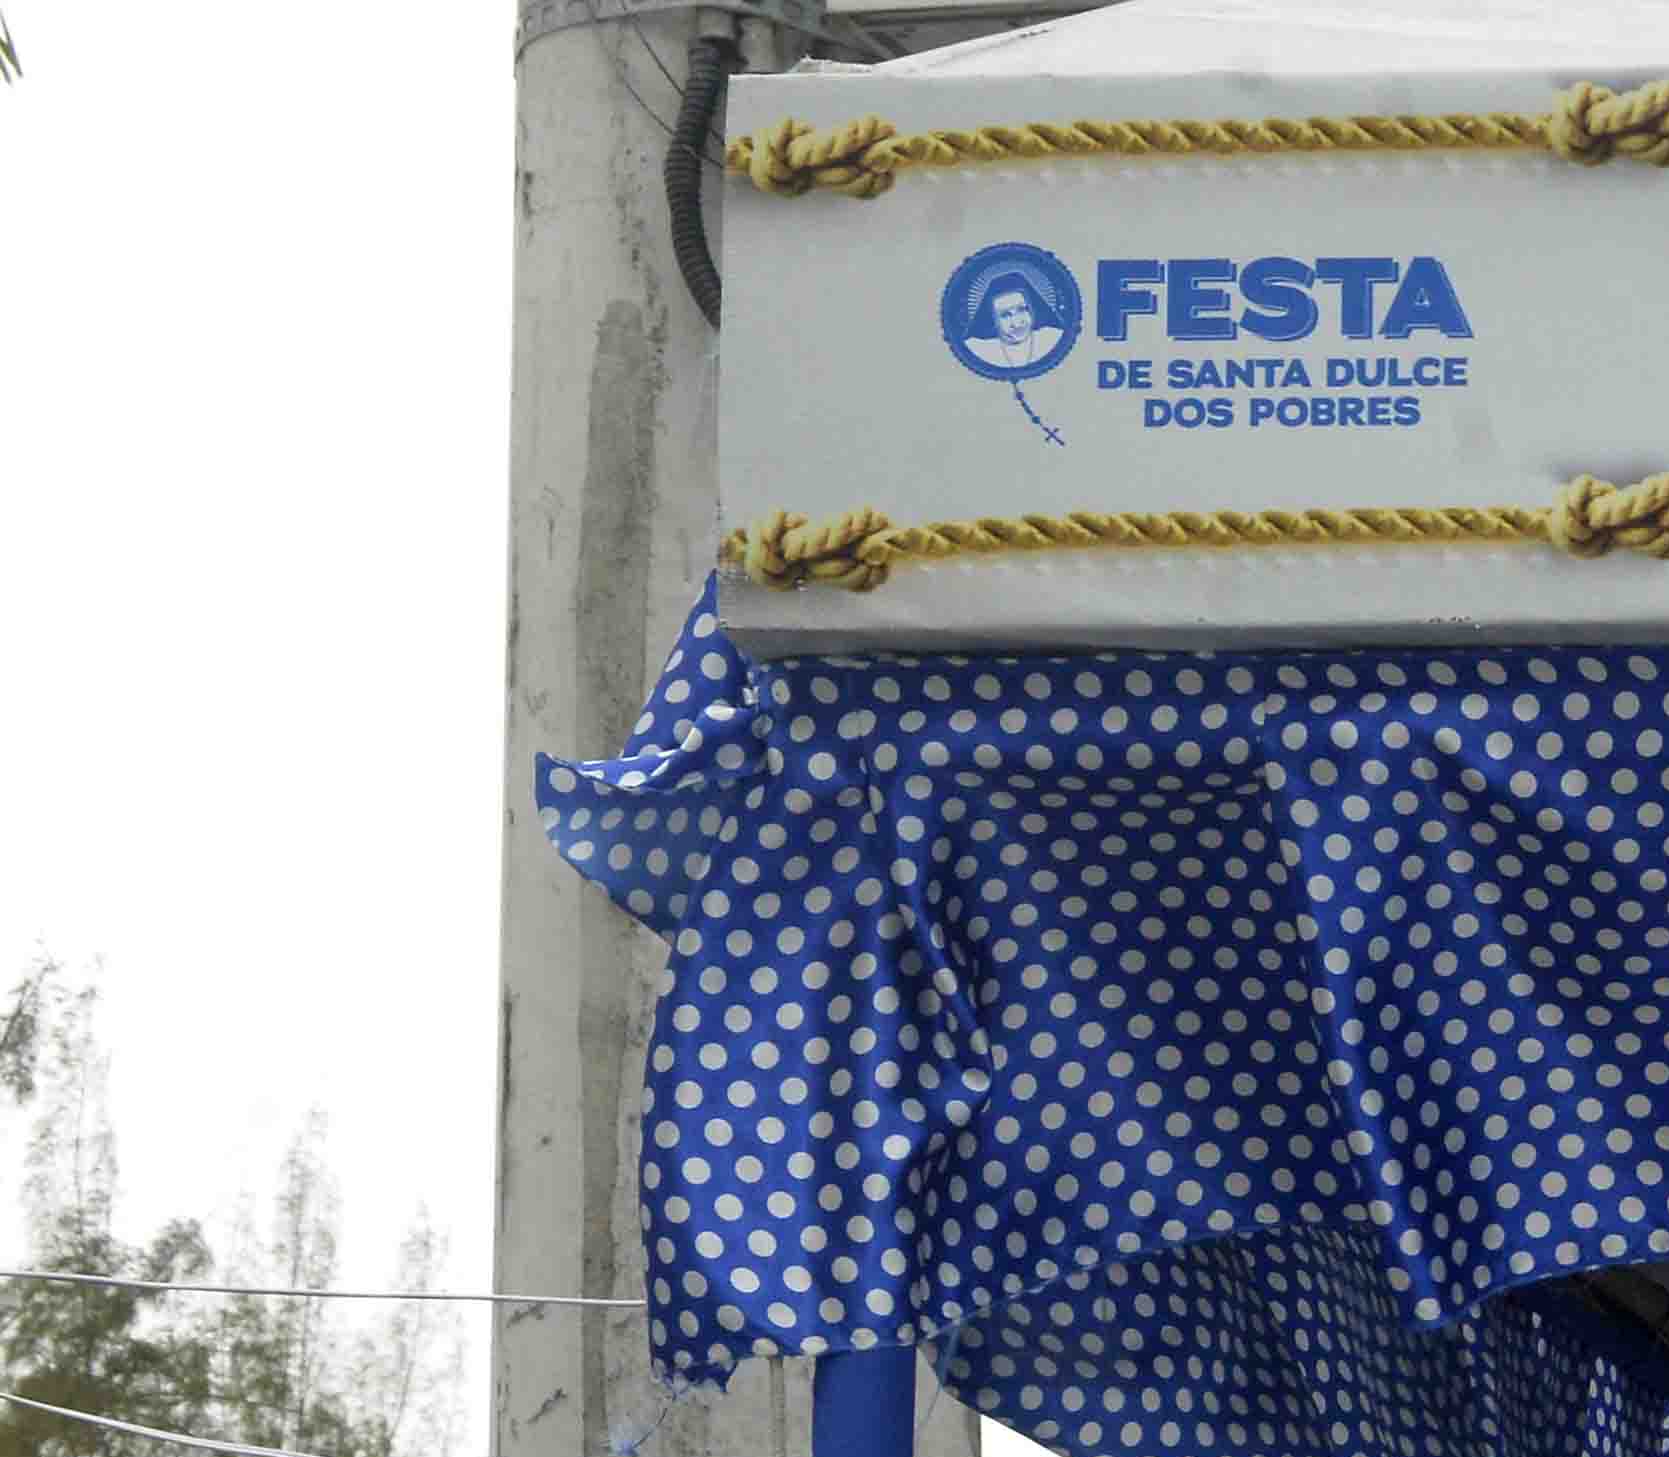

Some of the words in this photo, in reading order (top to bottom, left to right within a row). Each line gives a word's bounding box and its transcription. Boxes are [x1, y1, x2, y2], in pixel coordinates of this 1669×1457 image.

[1096, 256, 1474, 342] FESTA
[1097, 360, 1153, 390] DE
[1167, 358, 1311, 389] SANTA
[1326, 357, 1468, 388] DULCE
[1143, 398, 1234, 429] DOS
[1249, 397, 1421, 428] POBRES
